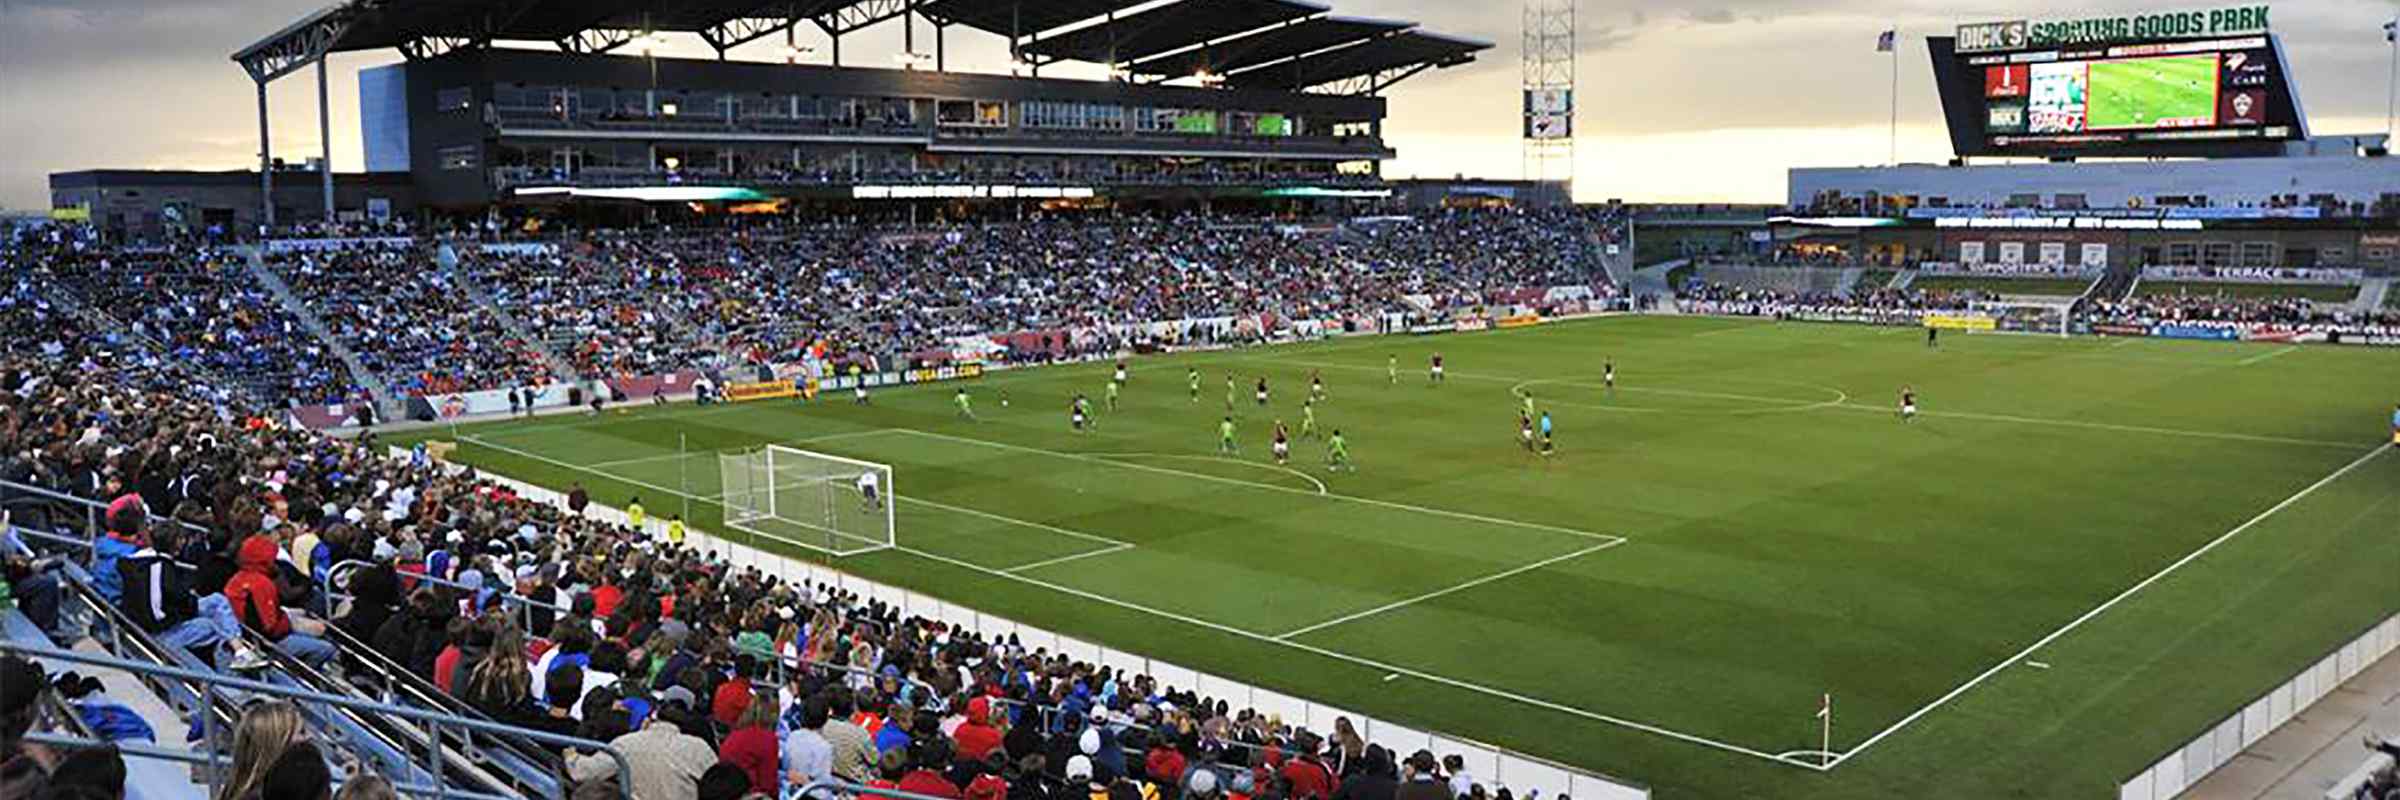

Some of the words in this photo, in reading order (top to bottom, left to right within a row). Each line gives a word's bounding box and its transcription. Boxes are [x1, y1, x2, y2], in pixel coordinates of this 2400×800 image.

[1959, 24, 2023, 48] DICK'S
[2031, 18, 2128, 45] SPORTING
[2133, 11, 2204, 37] GOODS
[2209, 5, 2269, 33] PARK
[2213, 266, 2282, 281] TERRACE
